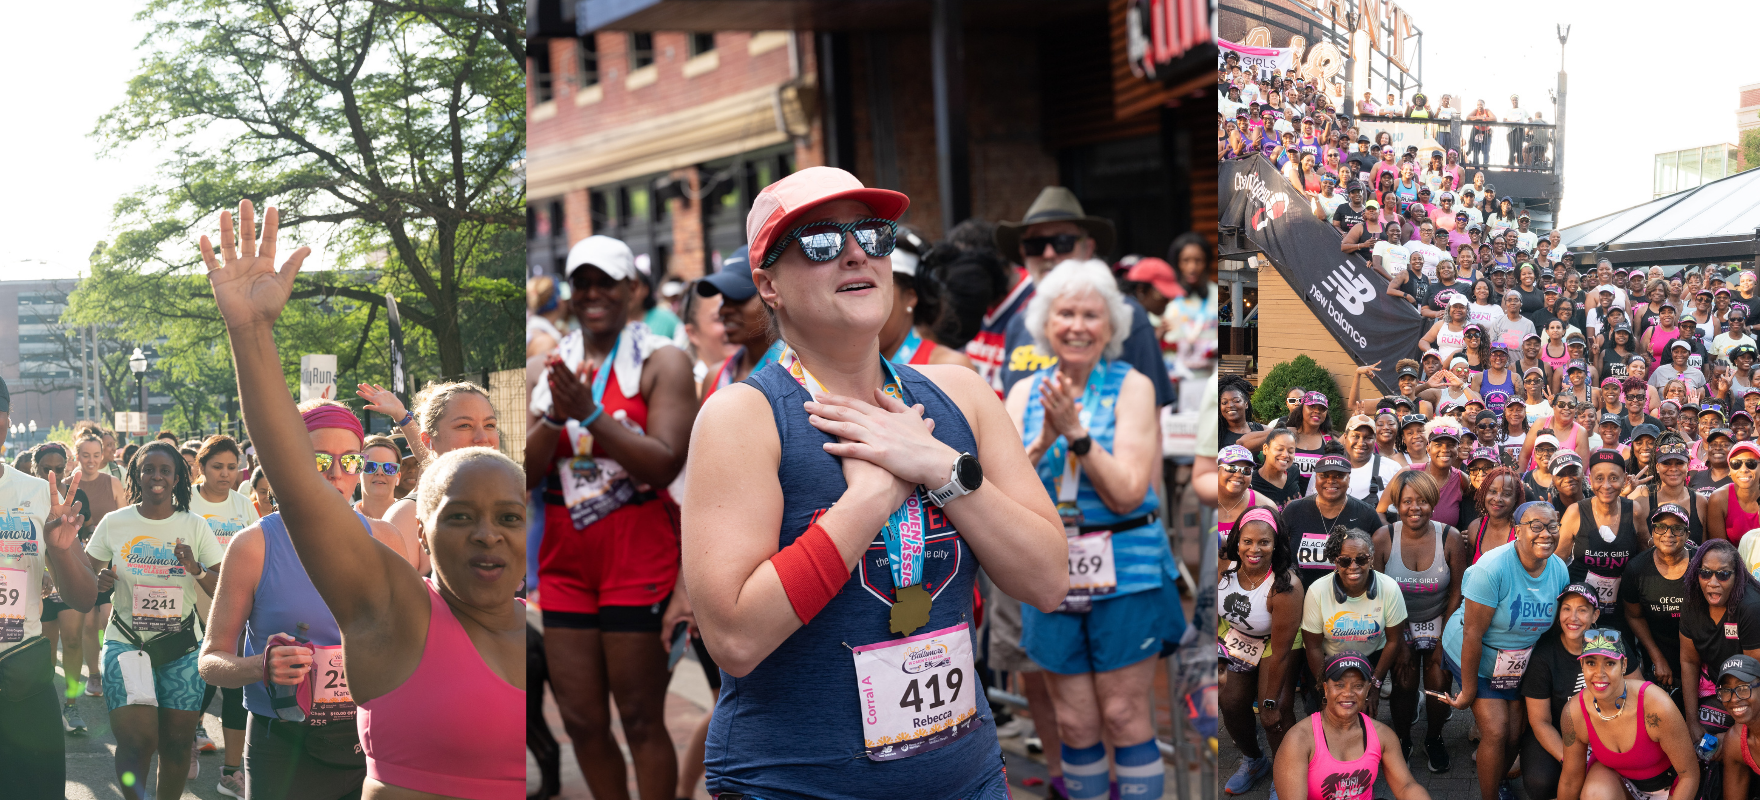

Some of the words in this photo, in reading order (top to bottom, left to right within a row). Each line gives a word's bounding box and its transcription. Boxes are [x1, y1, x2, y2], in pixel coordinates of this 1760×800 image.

[1242, 56, 1277, 69] GIRLS
[1309, 284, 1327, 310] new
[1327, 302, 1368, 349] balance
[1687, 359, 1702, 367] UN!
[1293, 462, 1316, 473] RUN
[1323, 459, 1344, 467] RUN!
[1301, 540, 1326, 548] BLACK
[876, 556, 889, 568] the
[933, 548, 949, 560] city
[899, 522, 913, 587] CLASSIC
[1299, 547, 1328, 563] RU
[1584, 549, 1608, 558] BLACK
[126, 553, 180, 567] Baltimore
[126, 562, 157, 570] WOMEN'S
[1584, 555, 1629, 570] RUN!
[131, 567, 144, 576] 5K
[1395, 576, 1418, 584] BLACK
[141, 598, 176, 610] 2241
[1659, 596, 1669, 604] Of
[1669, 596, 1684, 604] Cou
[1522, 601, 1554, 618] BWC
[1650, 604, 1661, 612] We
[1662, 604, 1680, 612] Have
[1331, 627, 1377, 637] Baltimore
[1414, 622, 1435, 632] 388
[1229, 637, 1258, 657] 2935
[908, 647, 943, 661] Baltimore
[1339, 660, 1360, 668] RUN!
[1506, 659, 1527, 671] 768
[1722, 659, 1743, 671] RUN!
[324, 669, 348, 689] 25
[861, 675, 873, 686] A
[899, 667, 963, 713] 419
[863, 686, 878, 725] Corral
[310, 719, 327, 727] 255
[912, 710, 953, 728] Rebecca
[1699, 711, 1726, 725] UN!
